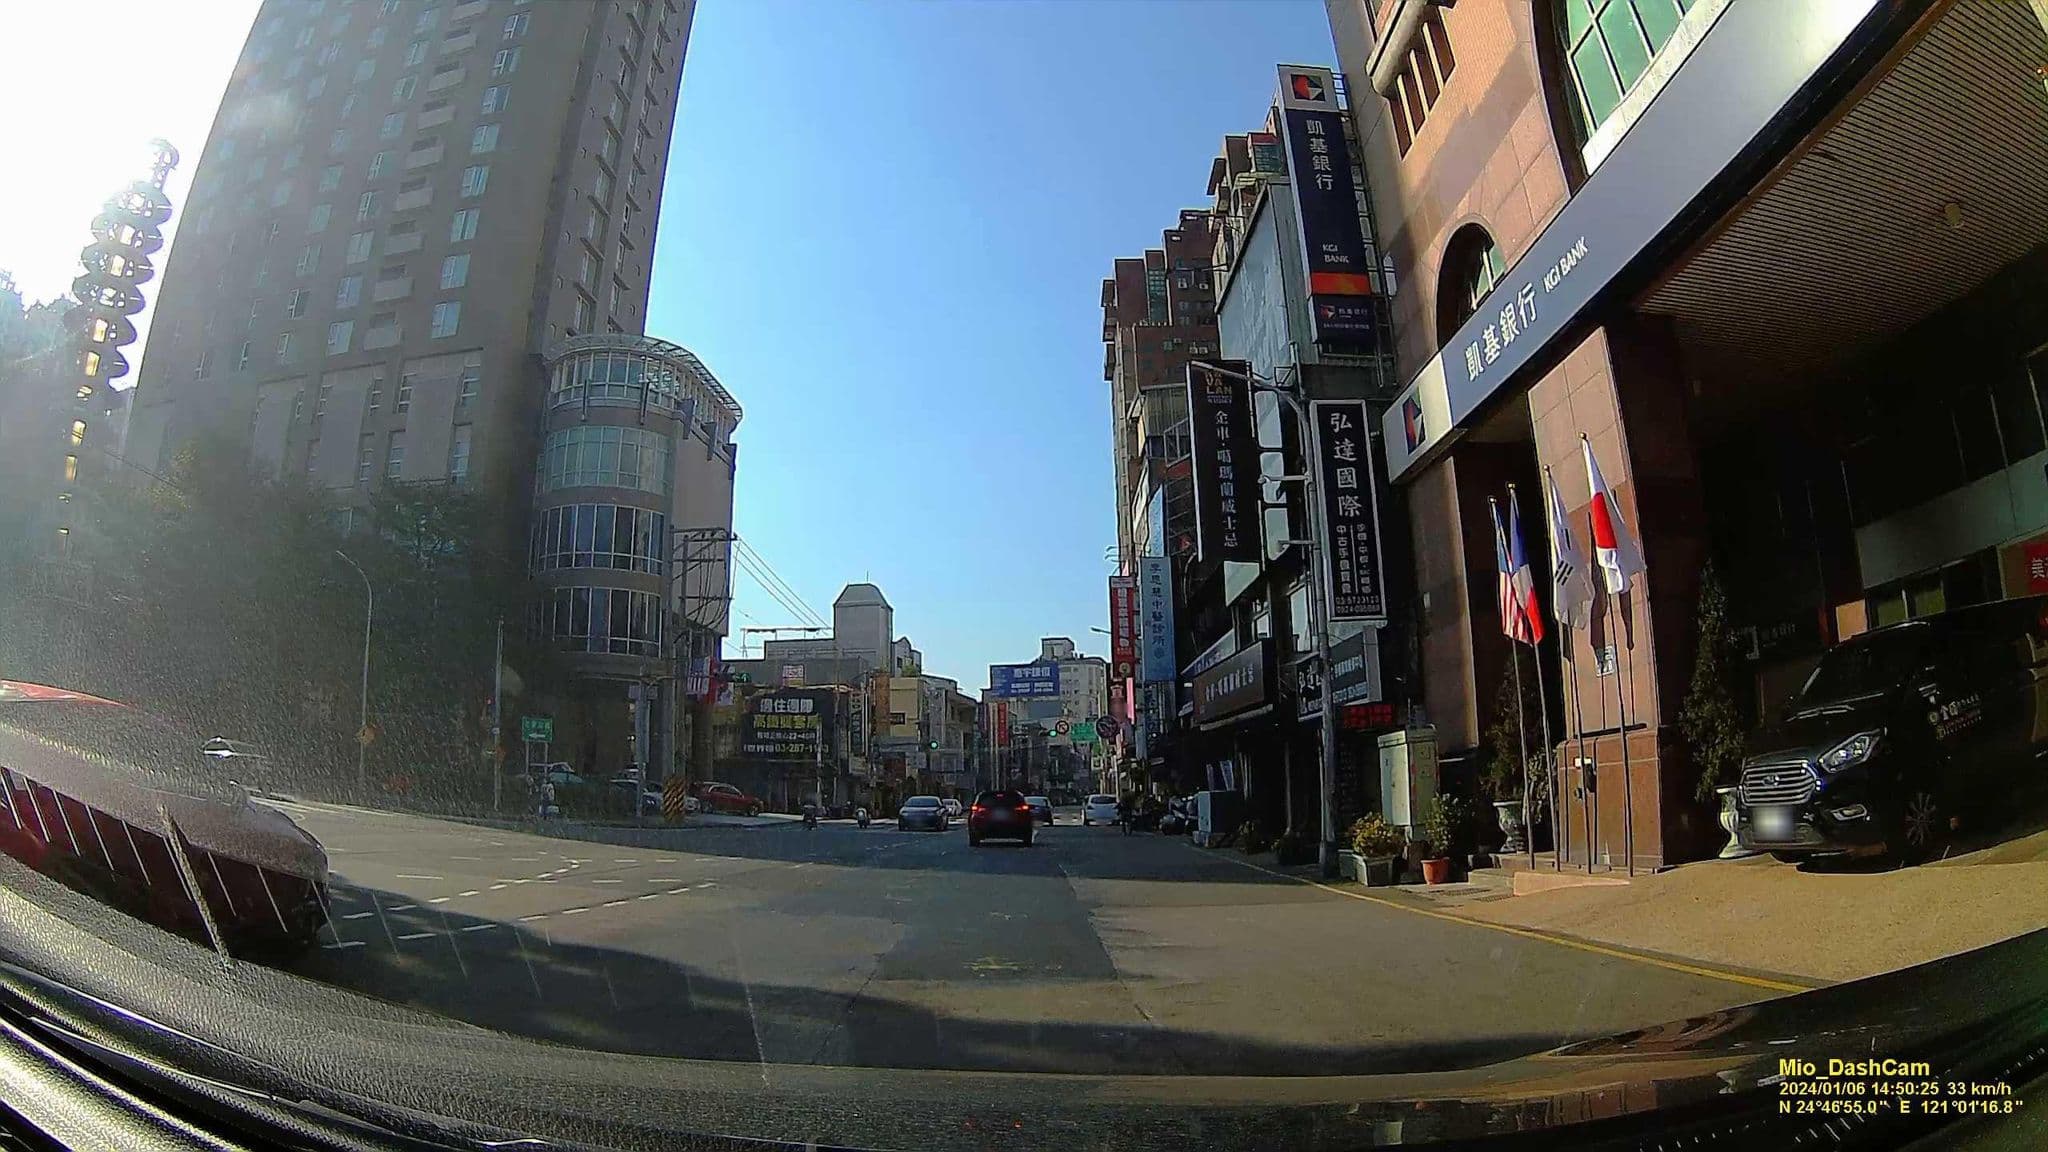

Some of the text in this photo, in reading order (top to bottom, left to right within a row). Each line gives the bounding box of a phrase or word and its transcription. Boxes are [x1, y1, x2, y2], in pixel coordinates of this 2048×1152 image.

[1306, 119, 1334, 191] 凱基銀行
[1322, 244, 1338, 252] KGI
[1324, 254, 1350, 263] BANK
[1543, 236, 1589, 293] KGI BANK
[1464, 282, 1538, 382] 凱基銀行
[1330, 412, 1362, 518] 弘達國際
